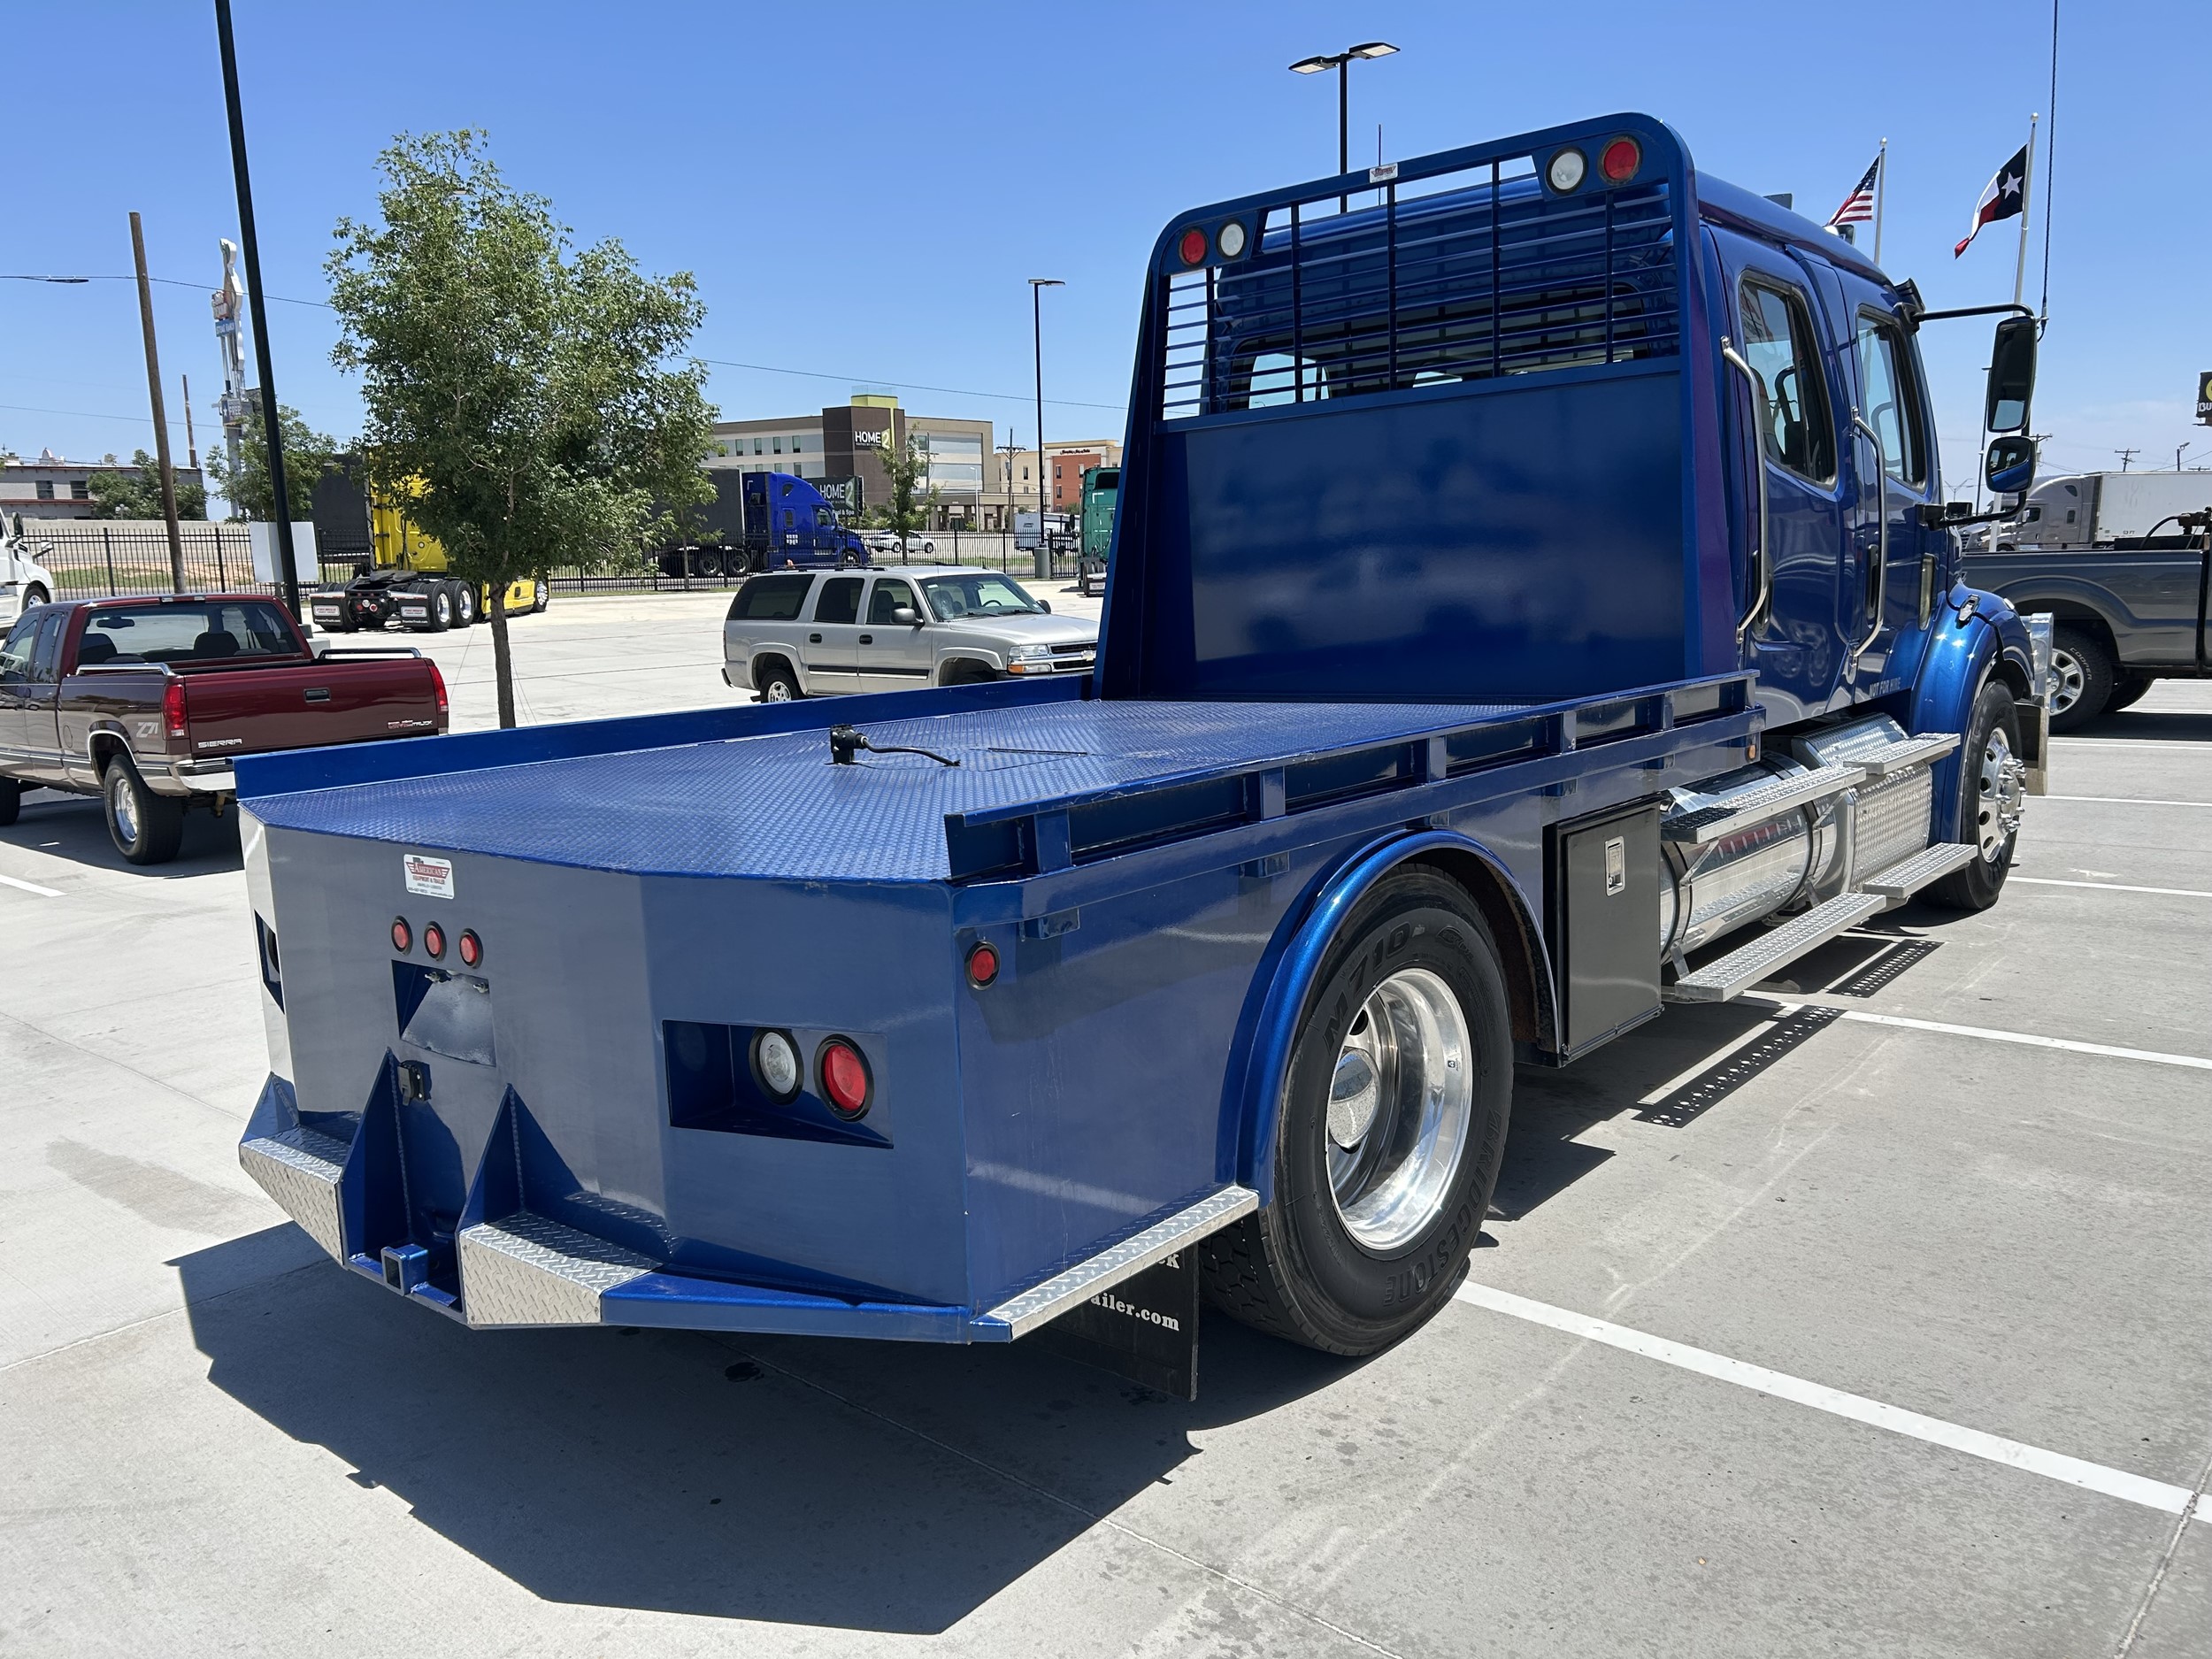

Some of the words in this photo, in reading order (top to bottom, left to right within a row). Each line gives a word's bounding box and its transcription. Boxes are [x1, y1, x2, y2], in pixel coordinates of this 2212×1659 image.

[2070, 648, 2093, 680] COOPER
[197, 738, 242, 749] SIERRA
[1383, 1109, 1503, 1307] BRIDGESTONE
